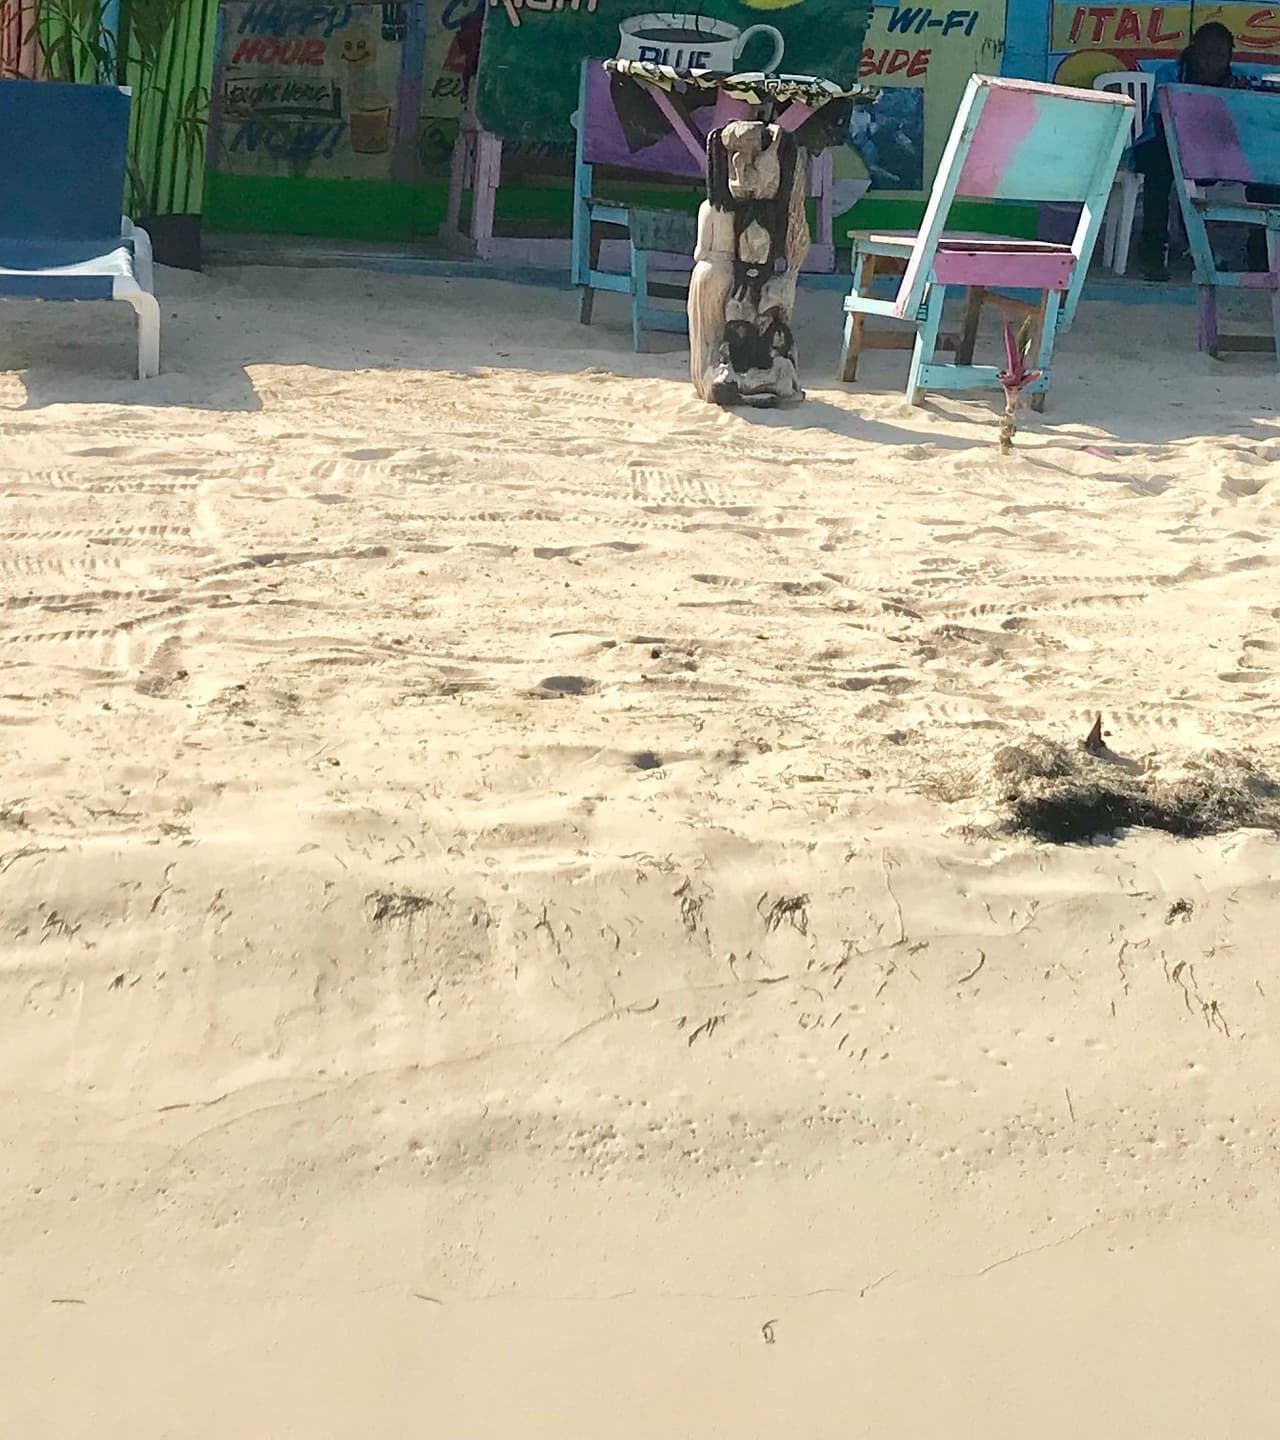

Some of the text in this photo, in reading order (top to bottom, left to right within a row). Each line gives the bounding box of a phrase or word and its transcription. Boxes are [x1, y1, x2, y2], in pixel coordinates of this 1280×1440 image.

[887, 7, 980, 37] WI-FI
[1068, 6, 1184, 47] ITAL
[231, 37, 327, 65] HOUR
